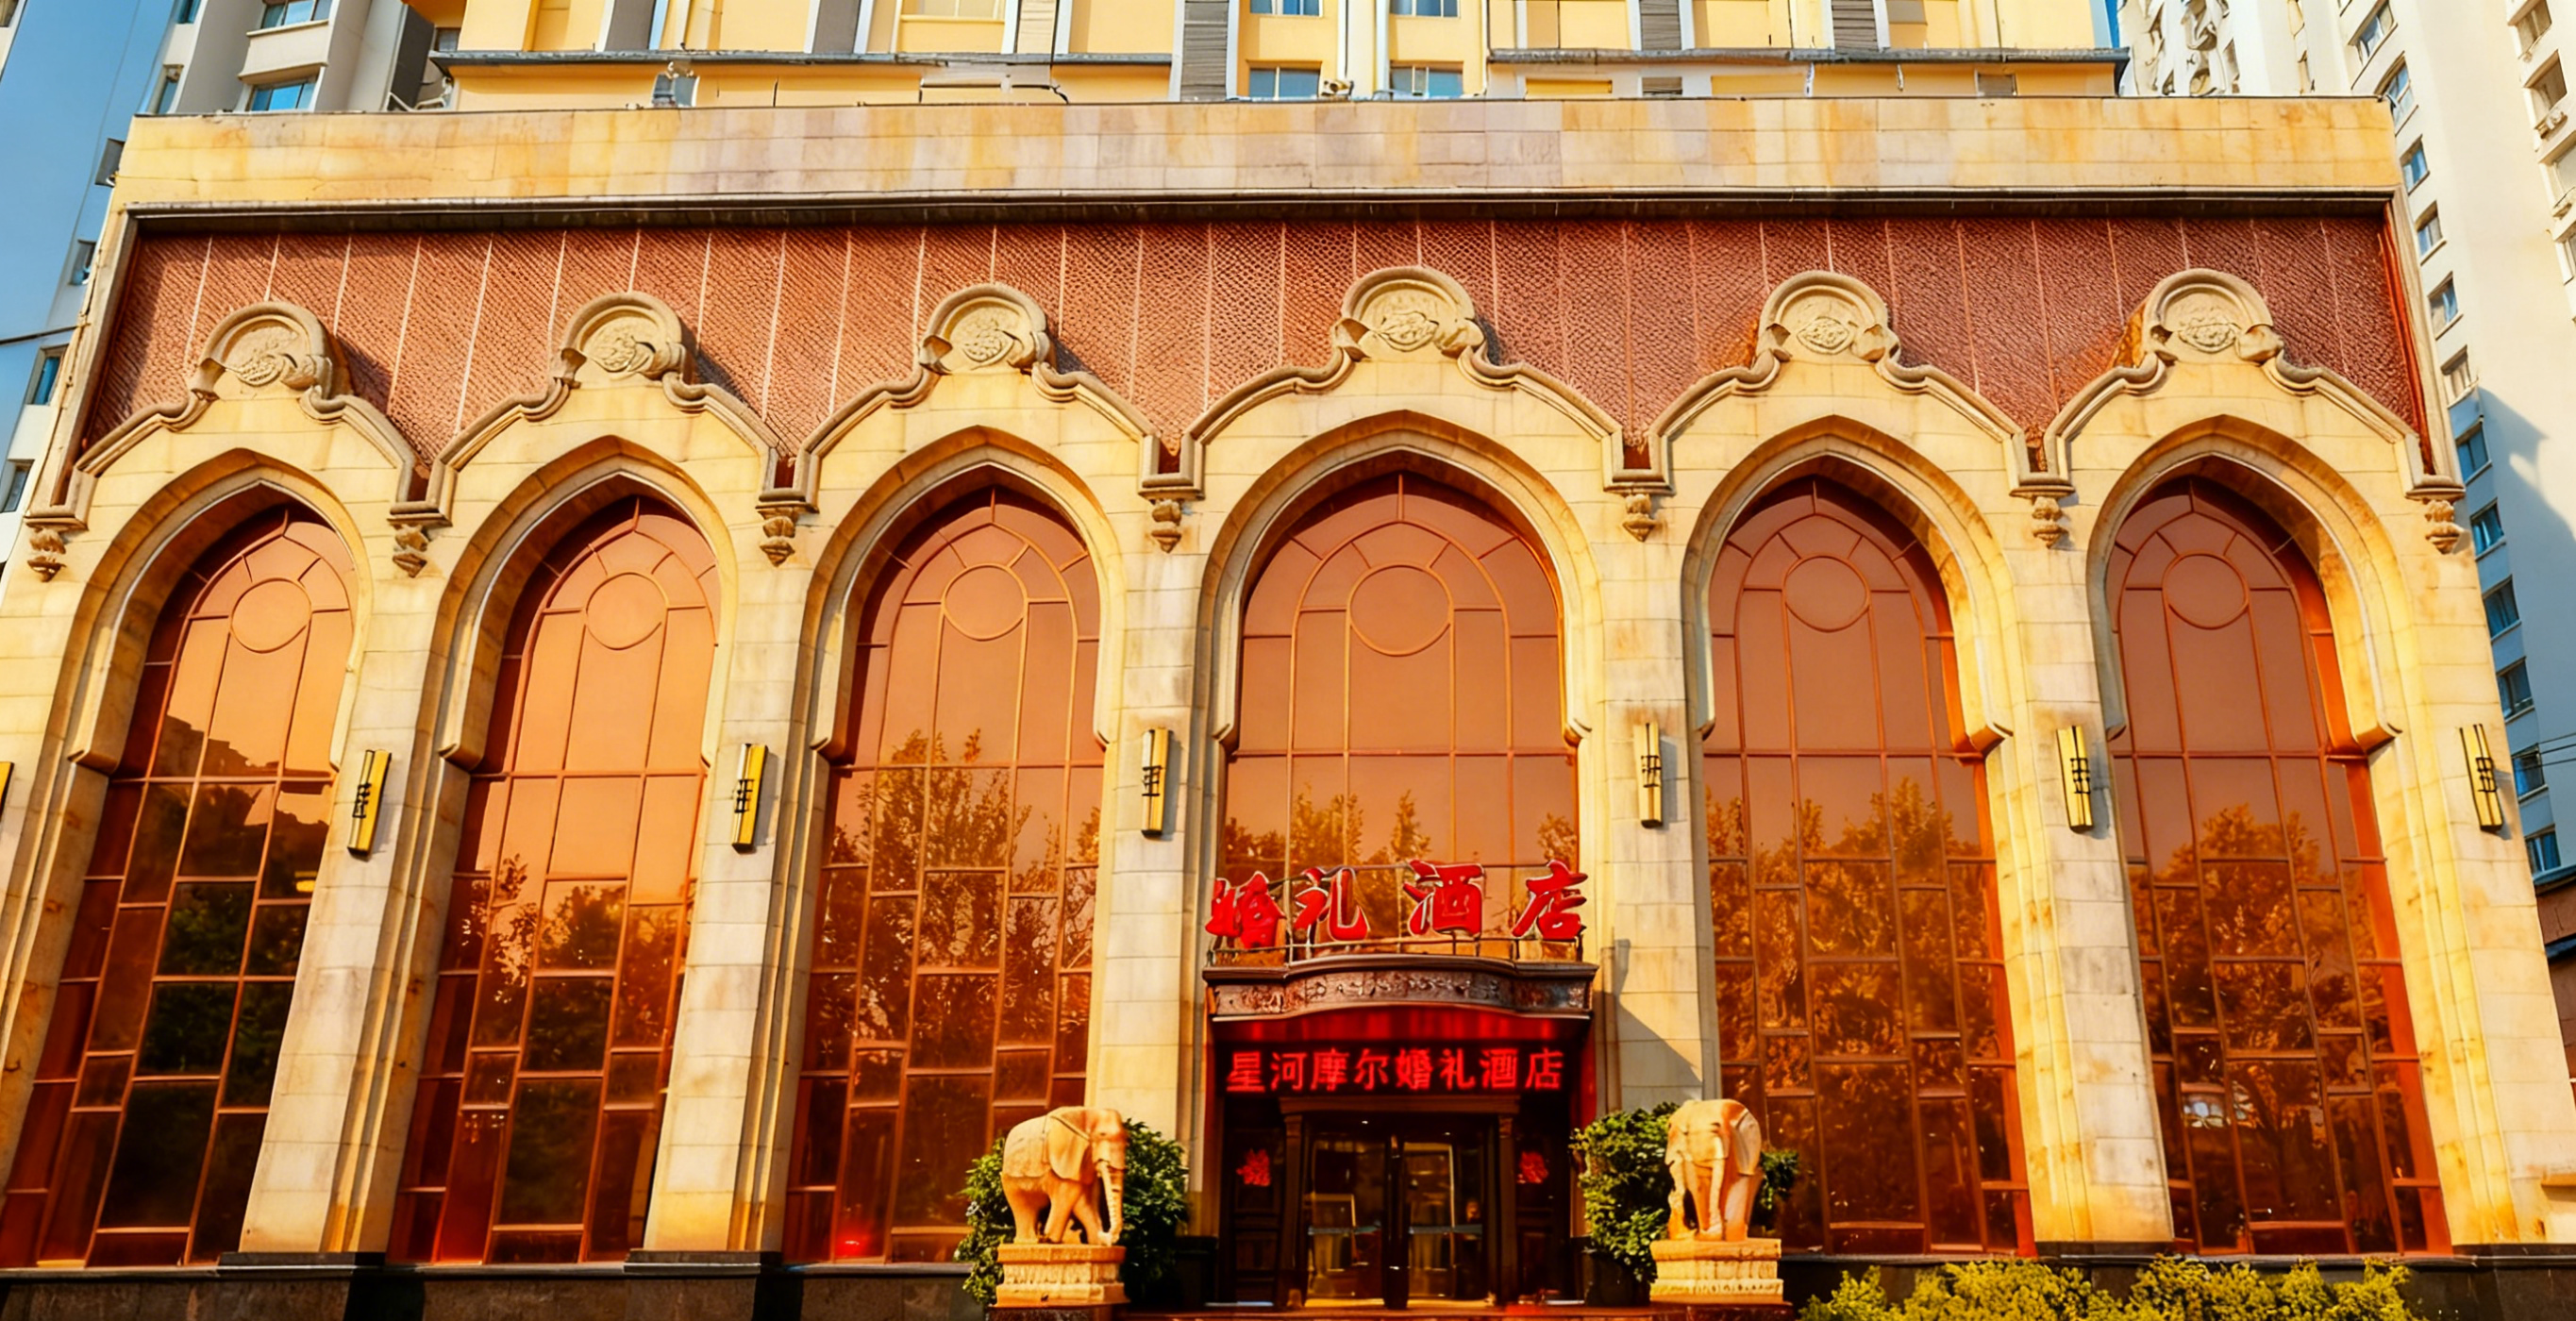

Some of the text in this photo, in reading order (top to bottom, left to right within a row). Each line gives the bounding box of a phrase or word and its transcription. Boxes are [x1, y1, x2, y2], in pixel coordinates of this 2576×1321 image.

[1227, 1047, 1564, 1093] 星河摩尔婚礼酒店
